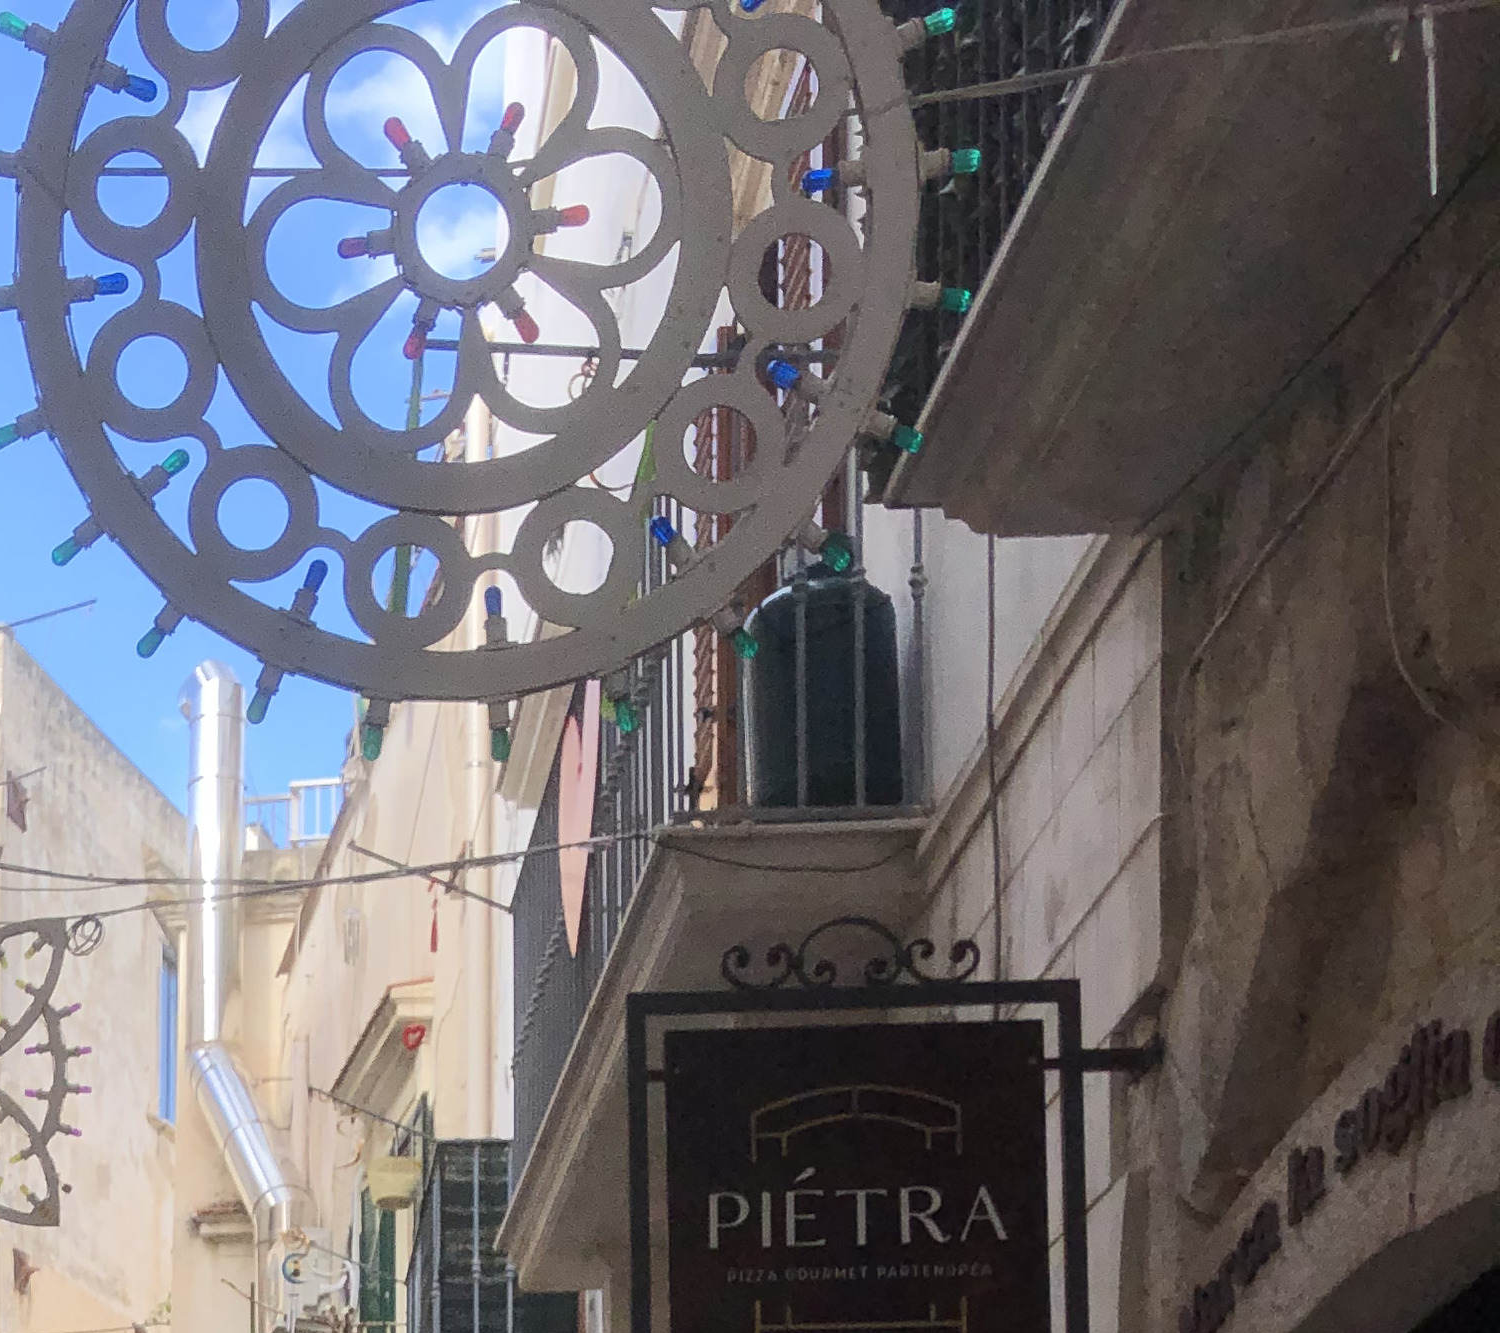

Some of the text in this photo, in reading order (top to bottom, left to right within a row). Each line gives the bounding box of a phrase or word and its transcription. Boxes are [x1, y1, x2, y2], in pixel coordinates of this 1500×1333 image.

[706, 1167, 1010, 1250] PIÉTRA
[726, 1266, 779, 1283] PIZZA
[784, 1264, 869, 1282] GOURMET
